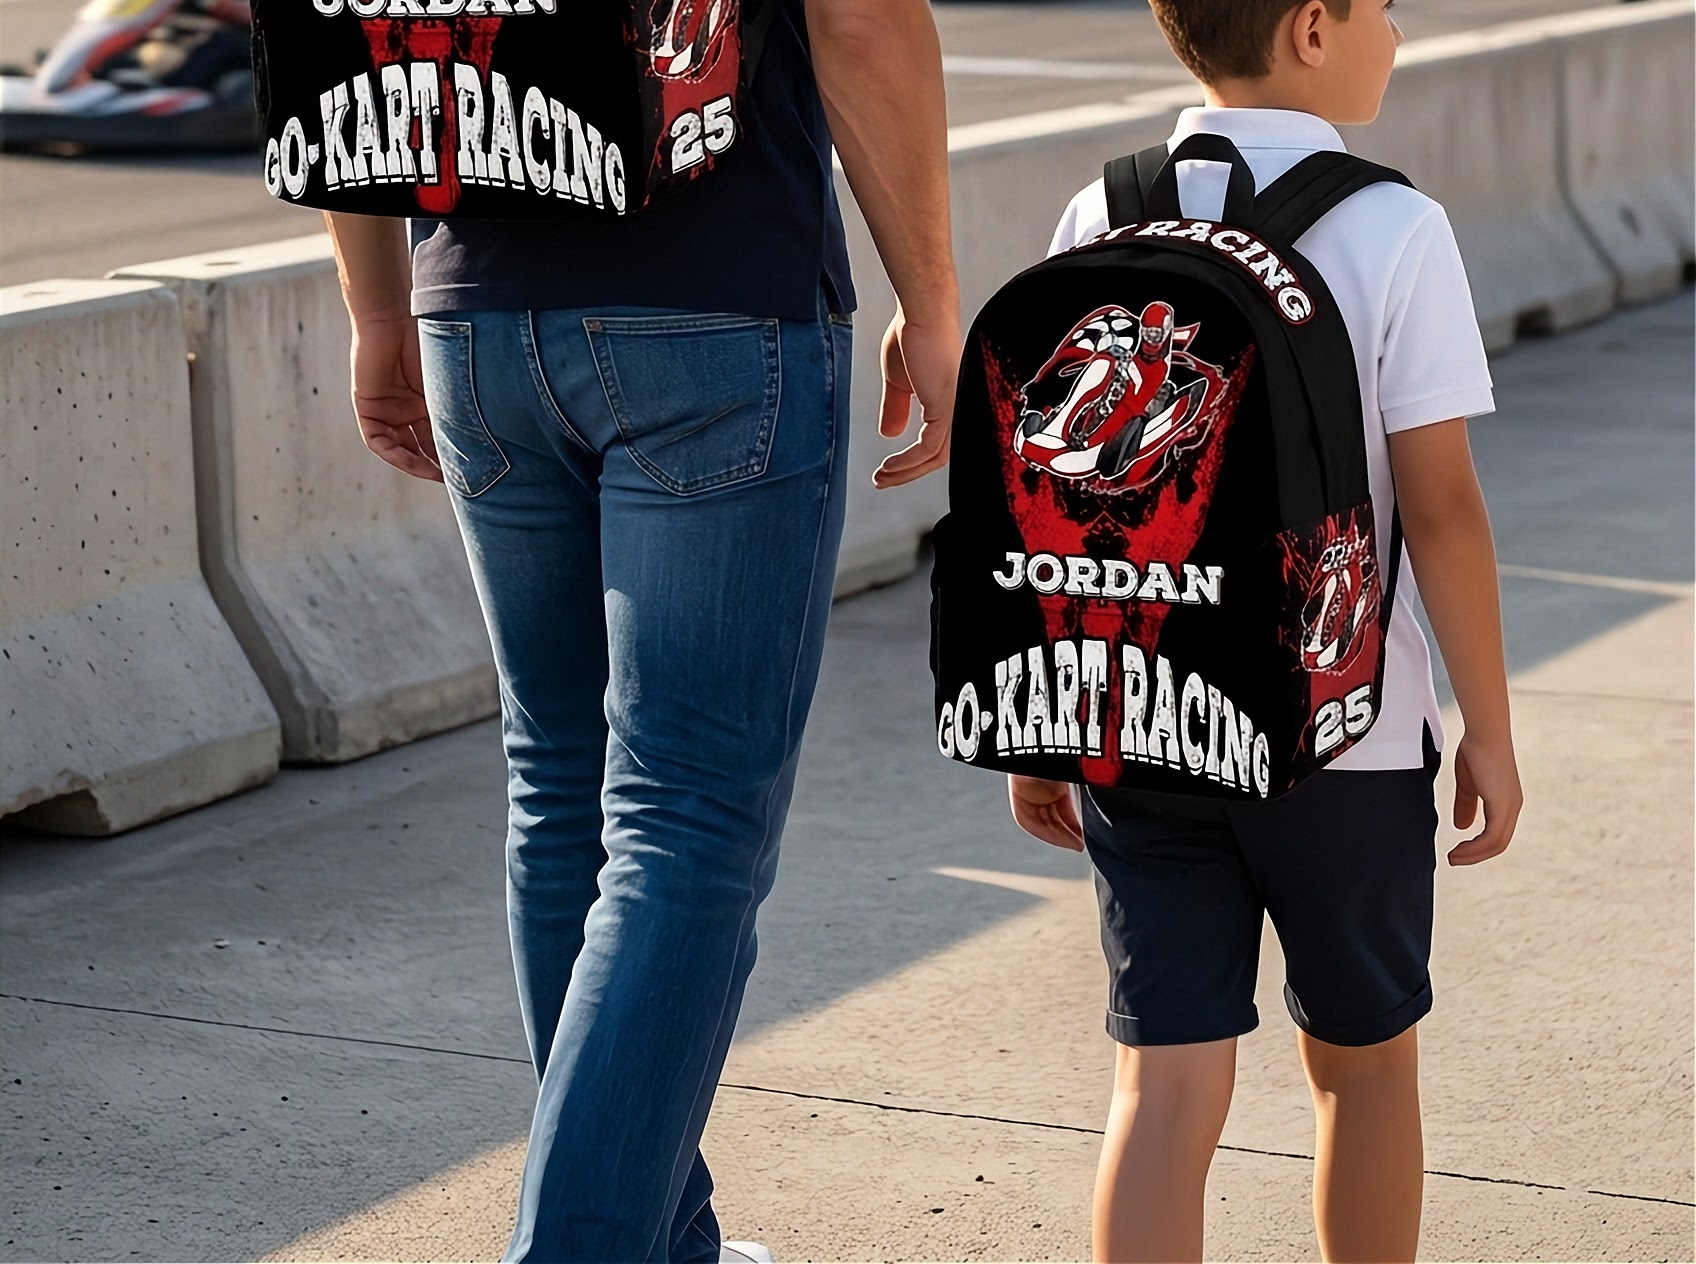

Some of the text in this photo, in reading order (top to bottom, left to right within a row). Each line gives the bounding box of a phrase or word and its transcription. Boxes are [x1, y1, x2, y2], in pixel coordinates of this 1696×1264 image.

[454, 63, 626, 216] RACING
[671, 97, 737, 174] 25
[1134, 220, 1312, 321] RACING
[992, 551, 1224, 604] JORDAN
[1121, 644, 1269, 799] RACING
[1314, 686, 1374, 758] 25
